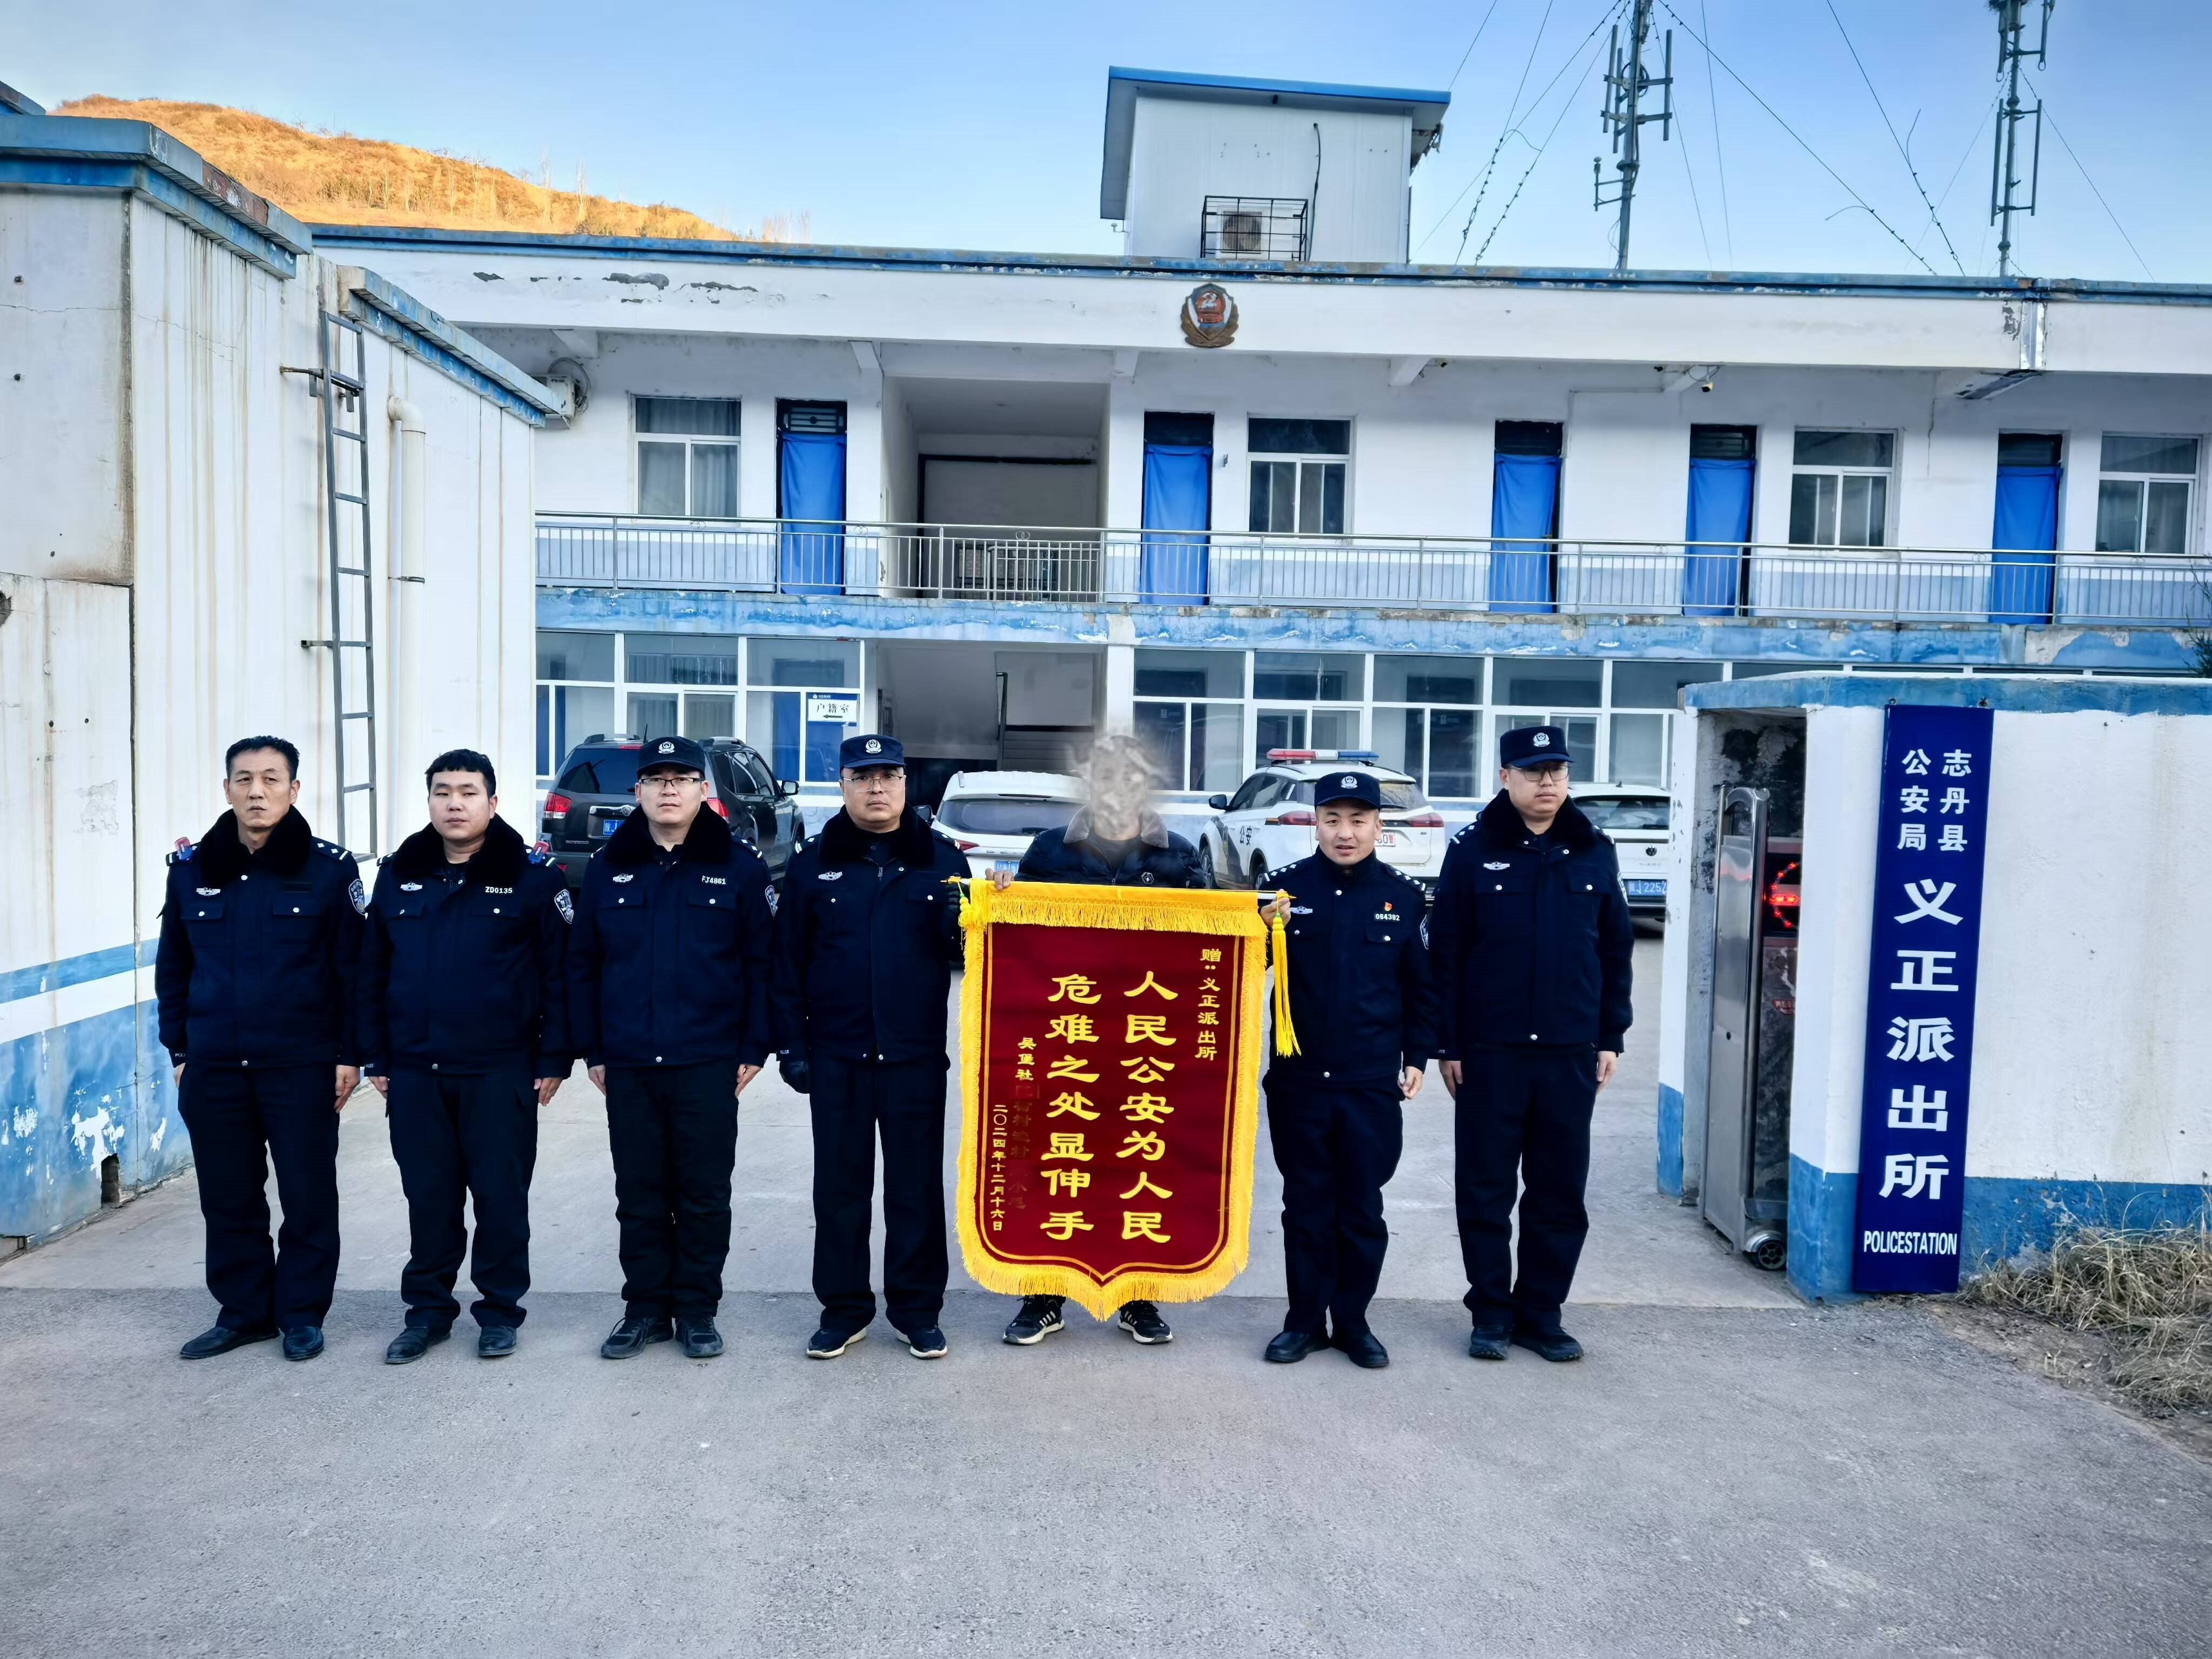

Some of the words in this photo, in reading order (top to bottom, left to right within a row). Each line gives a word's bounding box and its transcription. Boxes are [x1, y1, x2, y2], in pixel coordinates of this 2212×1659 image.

[1239, 825, 1252, 846] 公安
[1897, 748, 1930, 851] 公安局
[1938, 748, 1972, 852] 志丹县
[1375, 913, 1400, 921] 064392
[1879, 879, 1964, 1199] 义正派出所
[1040, 974, 1102, 1240] 危难之处显伸手
[1116, 970, 1178, 1243] 人民公安为人民
[1864, 1230, 1958, 1255] POLICESTATION
